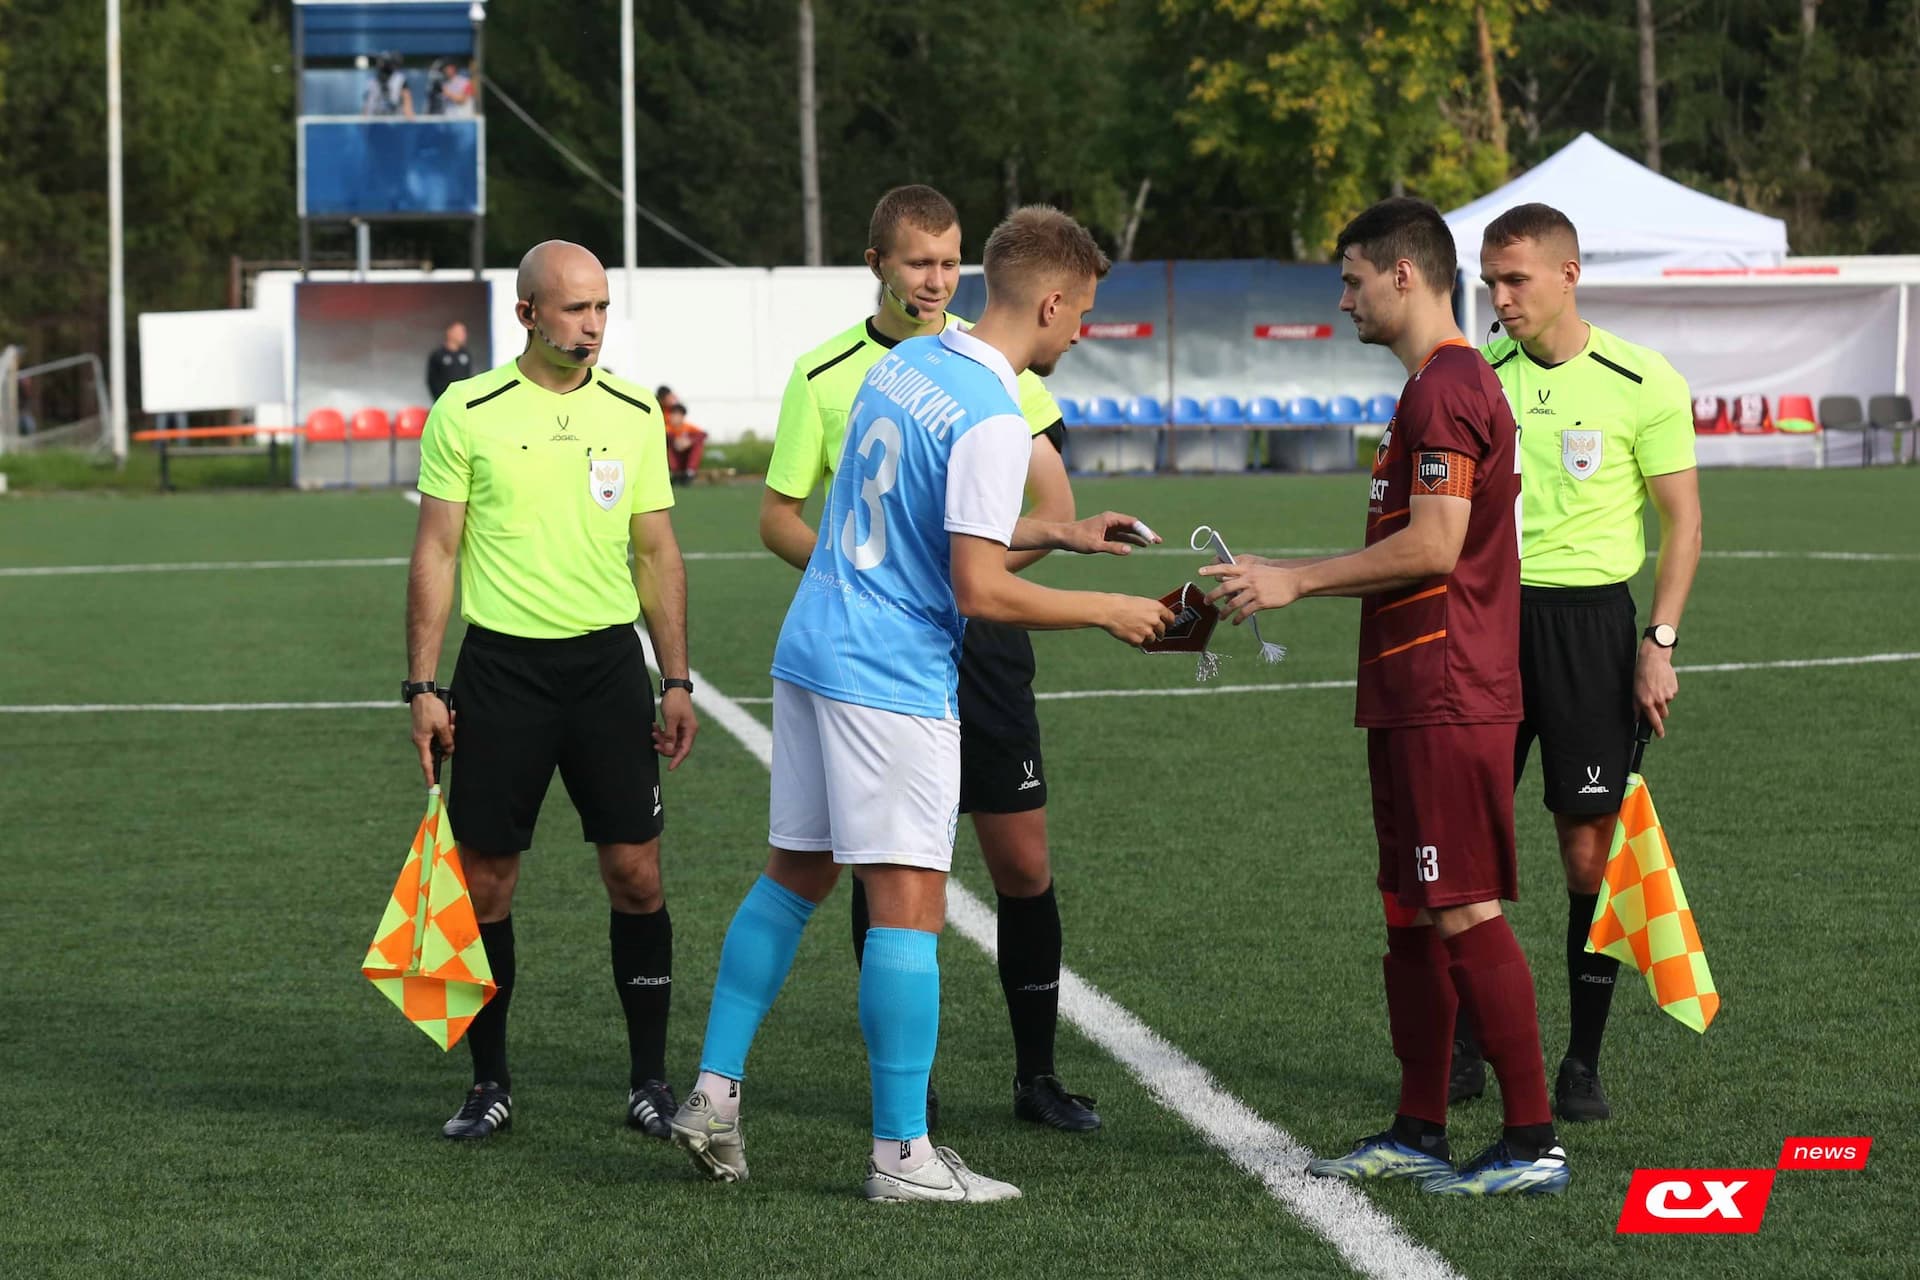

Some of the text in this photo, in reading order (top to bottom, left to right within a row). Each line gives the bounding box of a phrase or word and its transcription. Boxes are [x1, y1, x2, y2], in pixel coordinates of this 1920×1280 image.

[866, 354, 967, 441] БЫШКИН
[1526, 407, 1557, 415] JÖGEL
[1420, 463, 1447, 477] ТЕМП
[626, 975, 672, 985] JÖGEL
